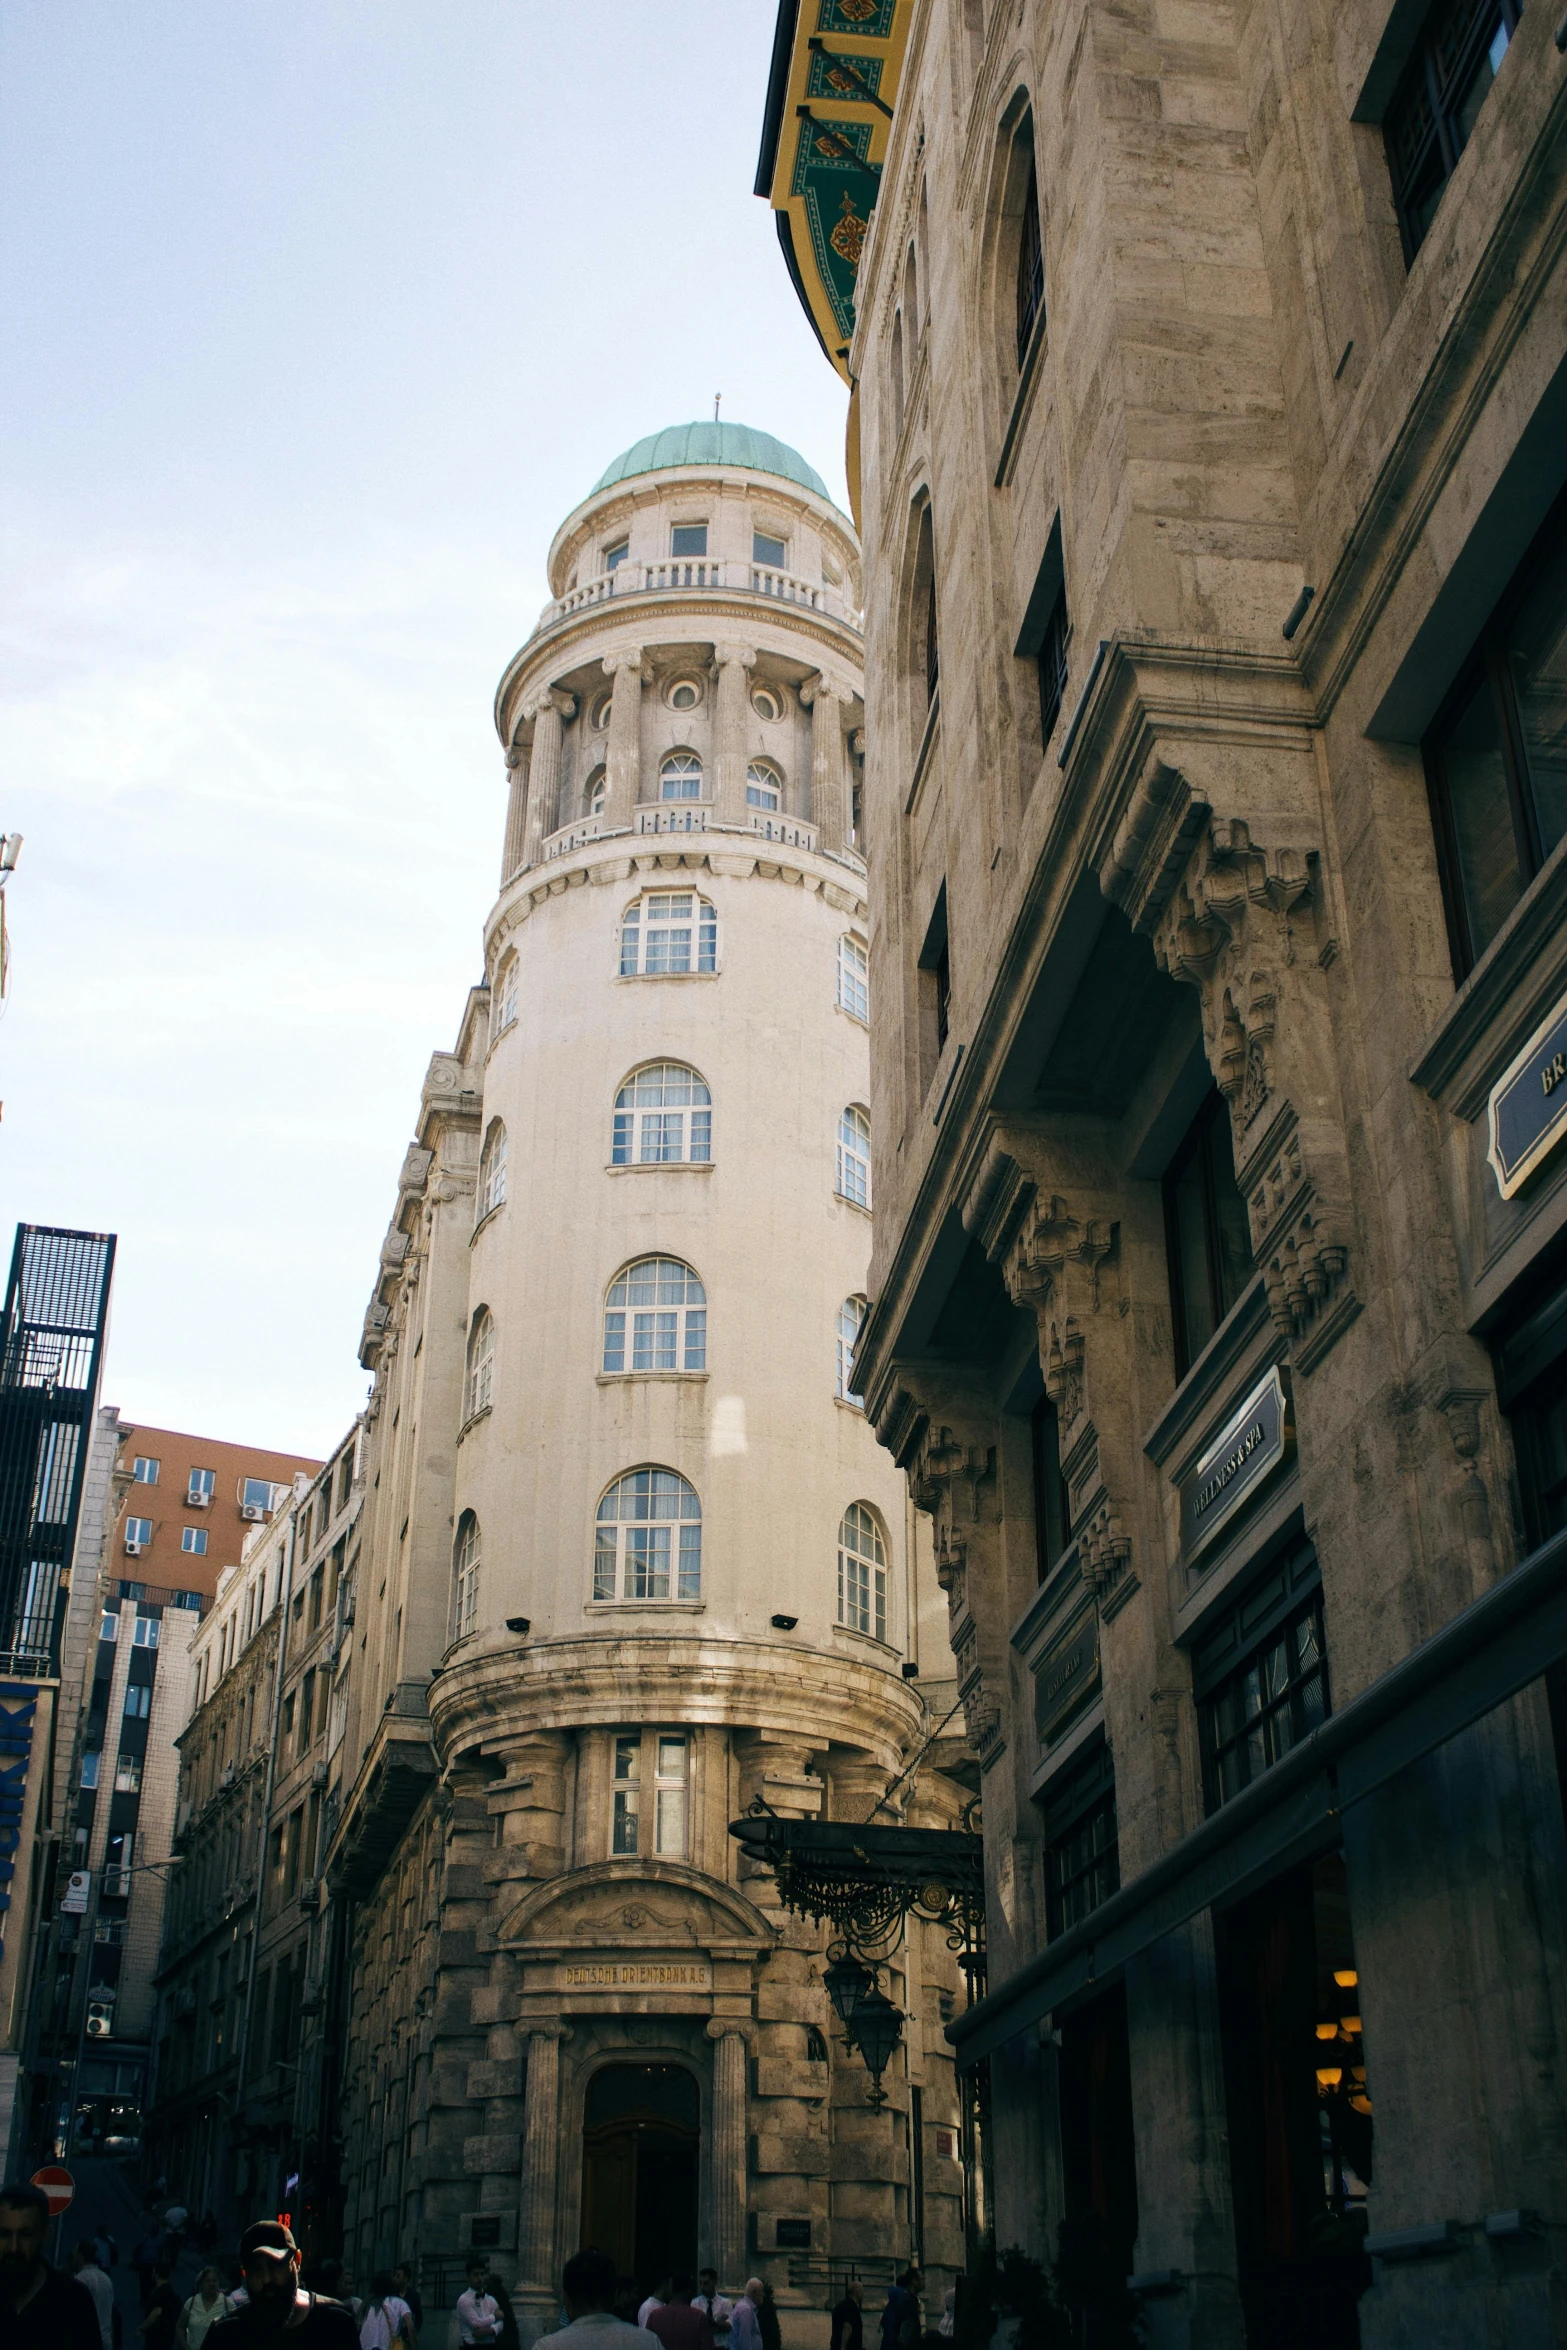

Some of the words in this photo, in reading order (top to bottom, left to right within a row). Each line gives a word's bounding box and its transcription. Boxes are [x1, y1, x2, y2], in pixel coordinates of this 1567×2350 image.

[1192, 1453, 1237, 1518] WELLNESS
[1237, 1444, 1246, 1466] &
[1245, 1422, 1265, 1455] SPA
[565, 1967, 617, 1985] DEUTSCHE
[621, 1966, 687, 1984] ORIENTBANK
[689, 1967, 707, 1984] A.G.
